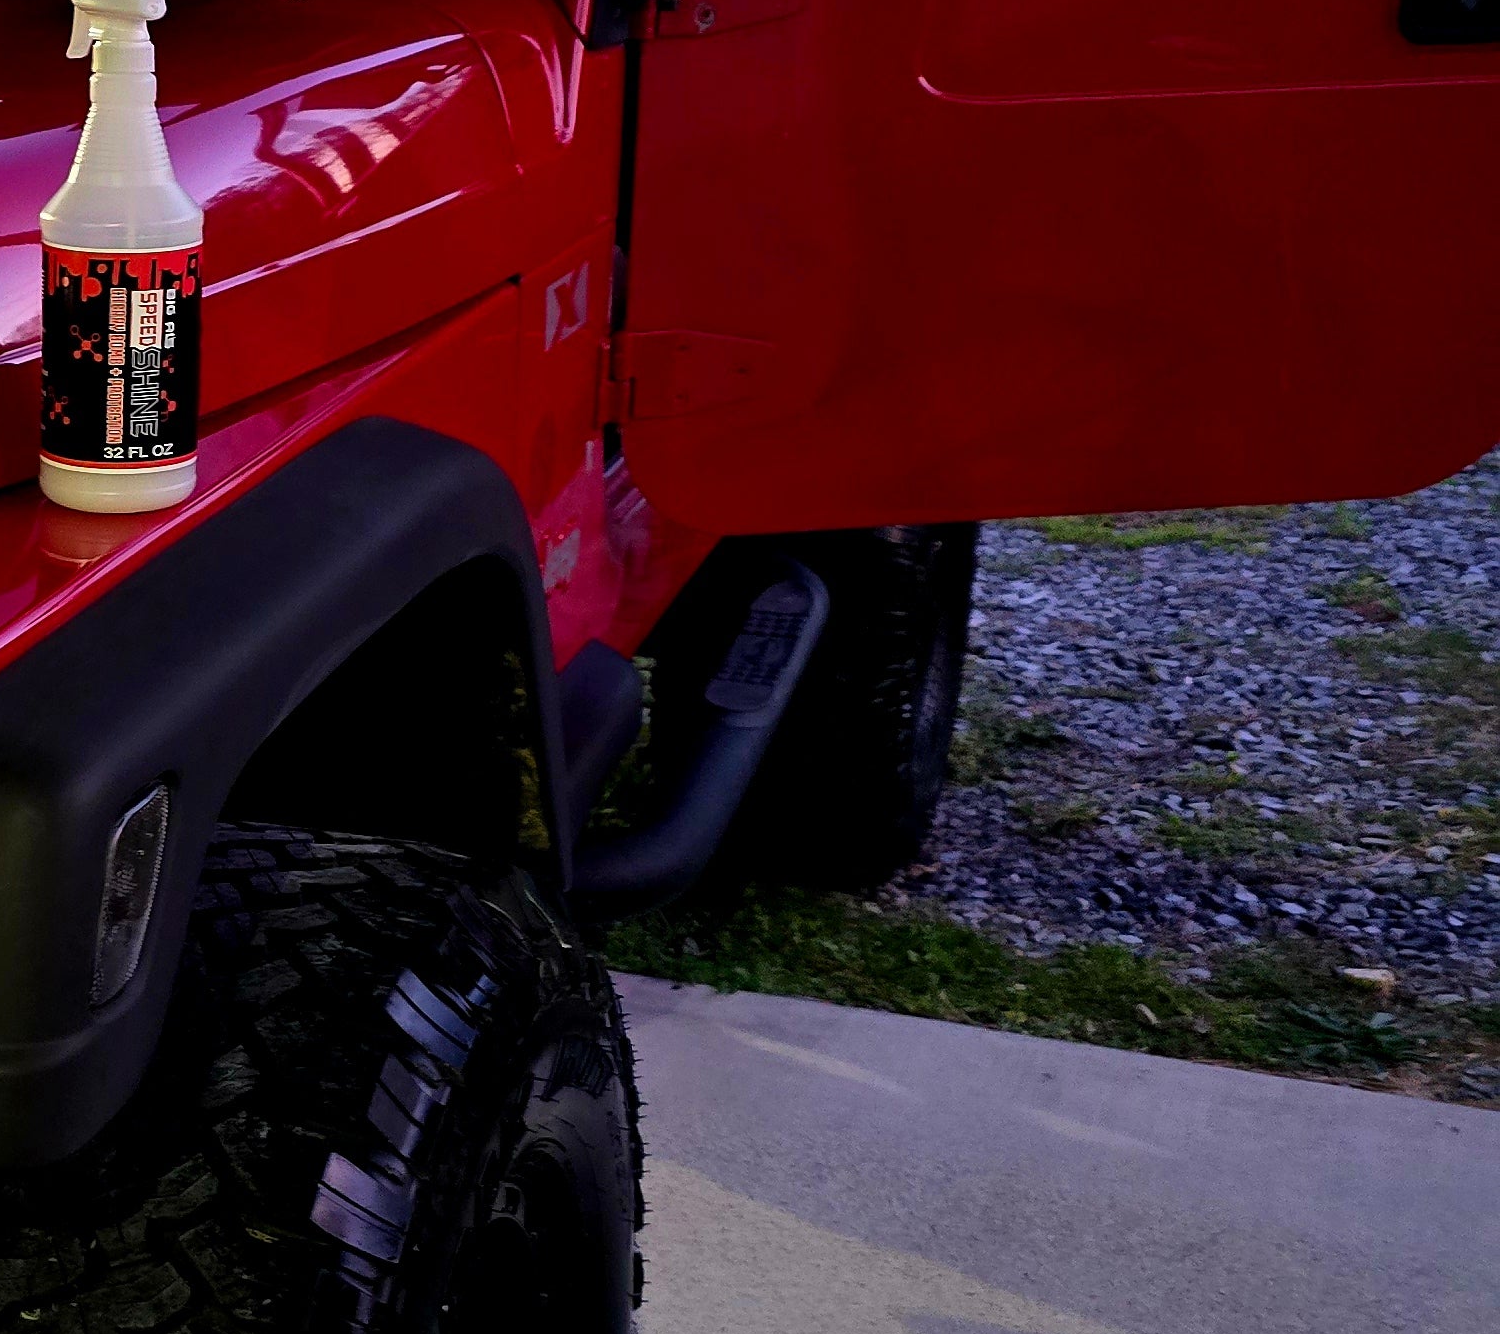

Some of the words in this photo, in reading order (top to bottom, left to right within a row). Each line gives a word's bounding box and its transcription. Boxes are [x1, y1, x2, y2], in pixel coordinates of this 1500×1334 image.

[138, 292, 157, 346] SPEED
[106, 378, 124, 443] PROTECTION
[130, 349, 160, 437] SHINE
[104, 447, 124, 458] 32
[128, 447, 148, 458] FL
[152, 443, 173, 456] OZ
